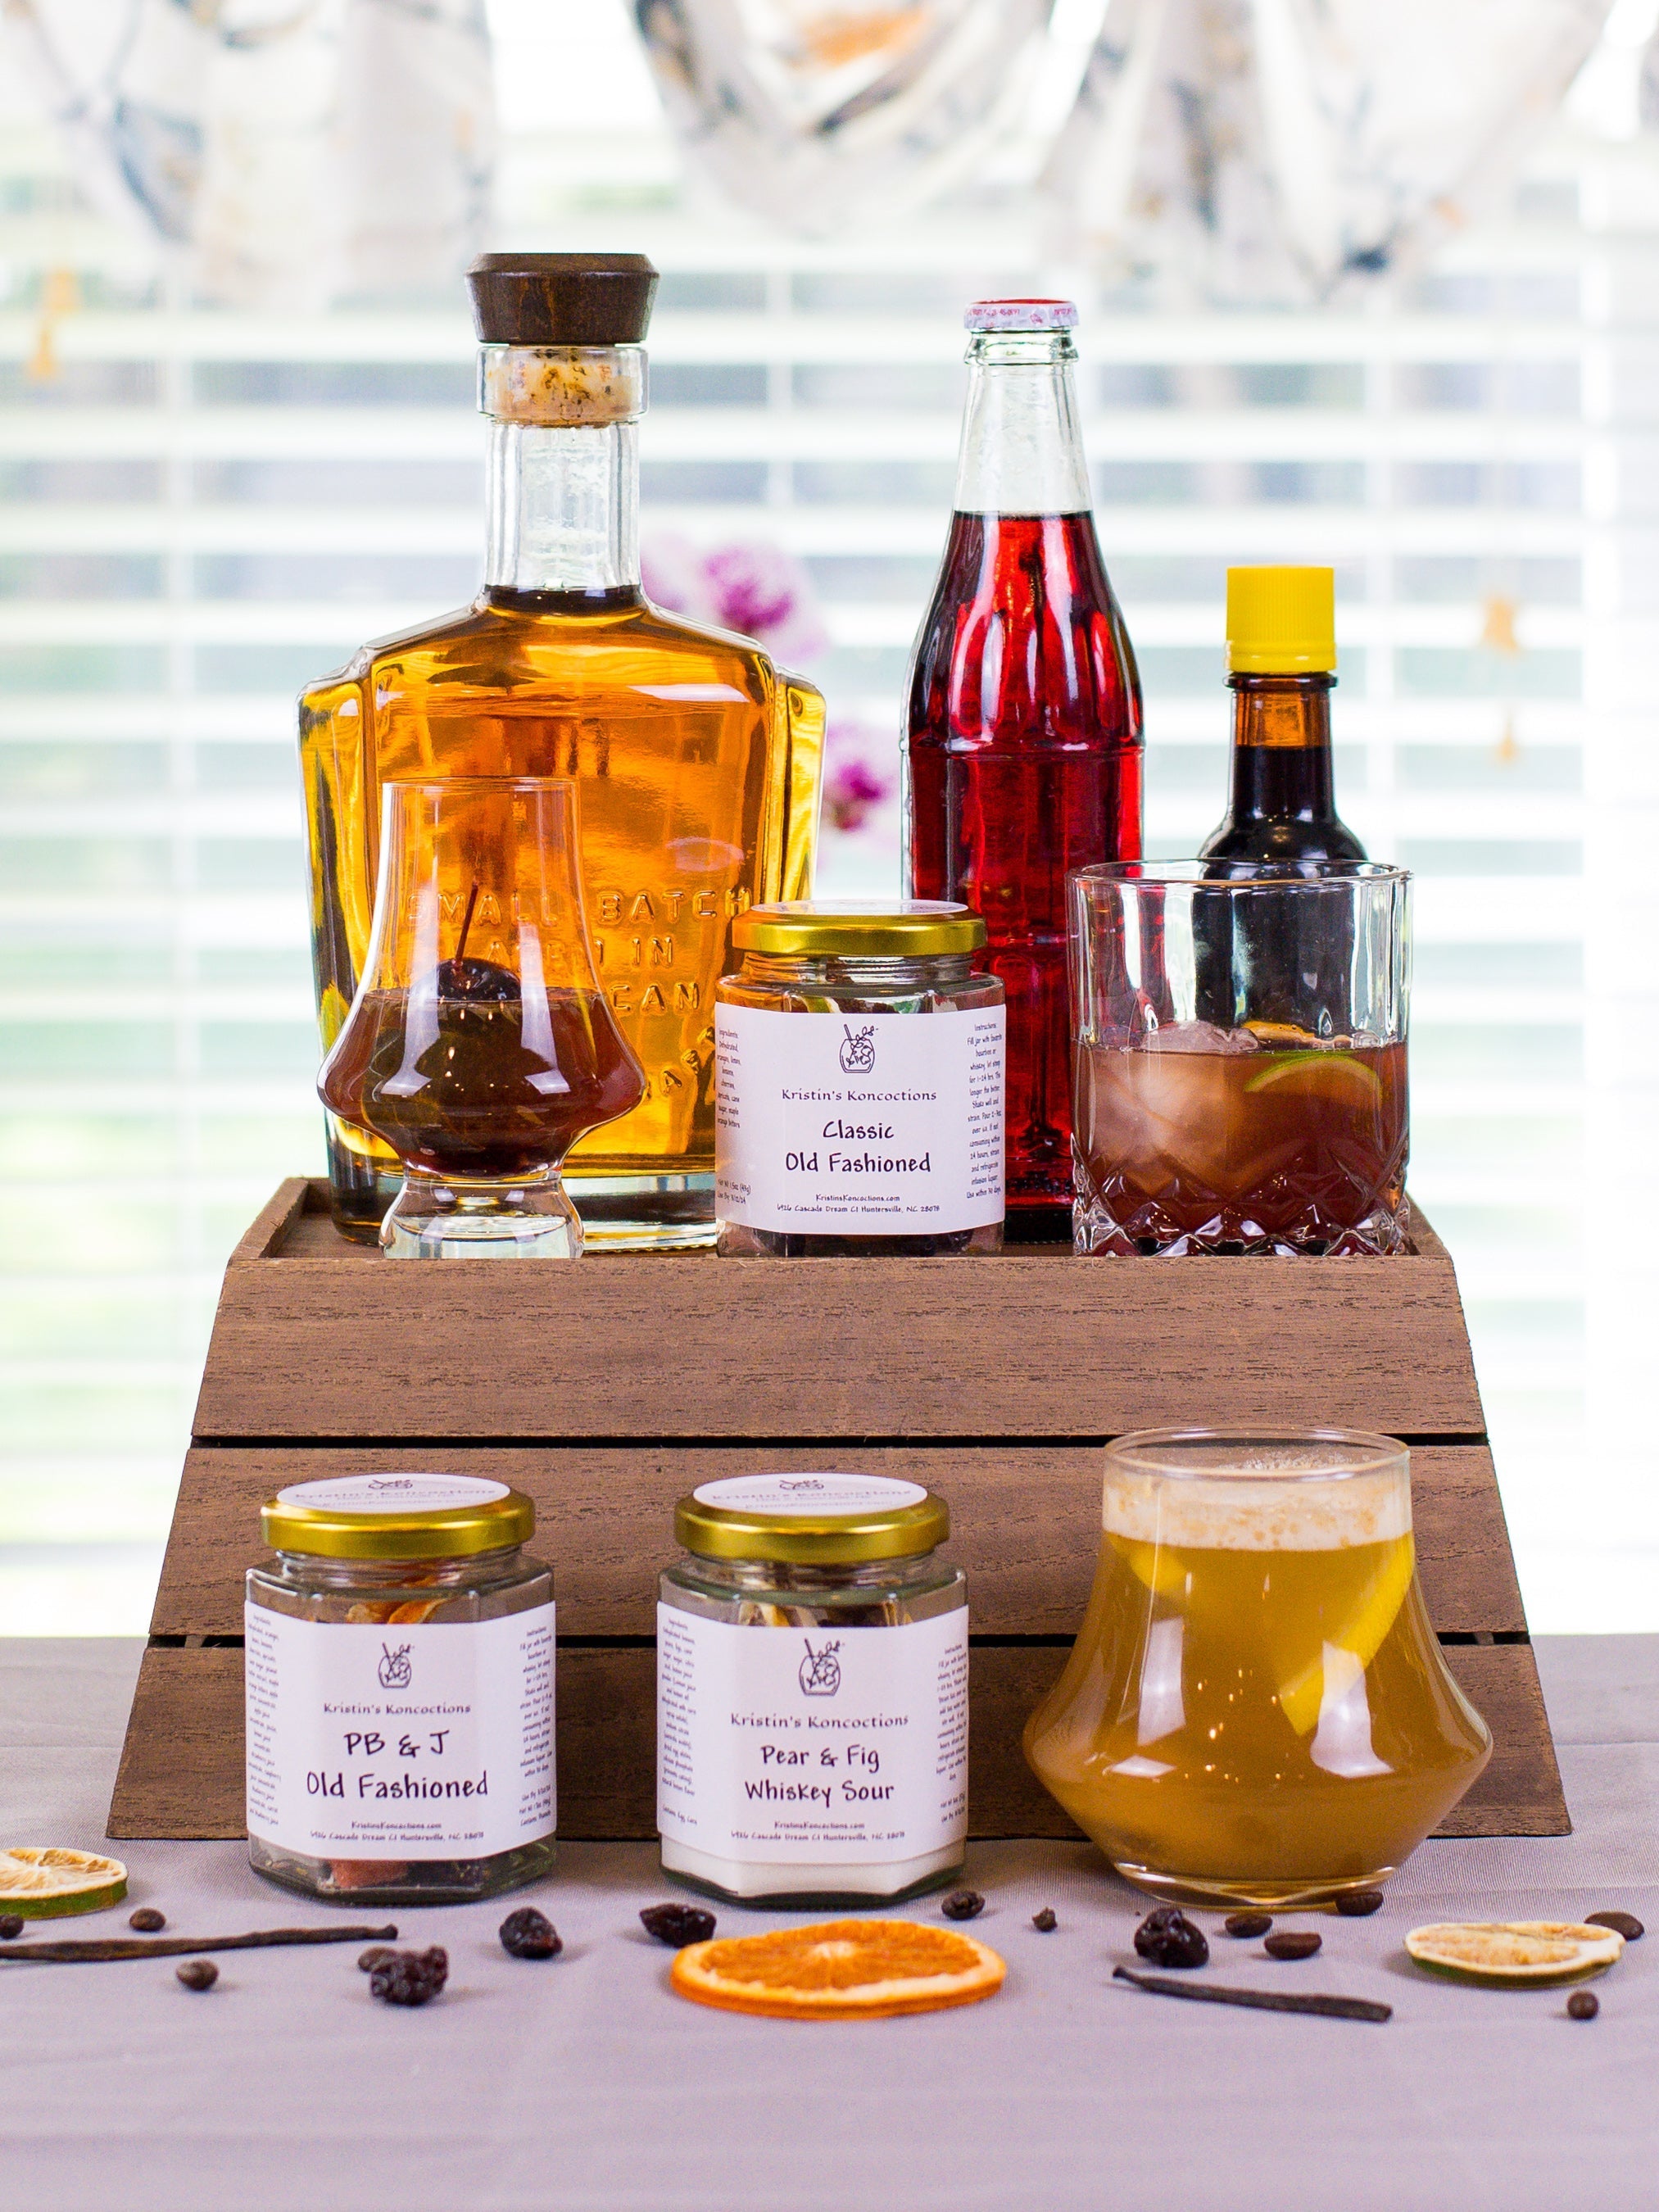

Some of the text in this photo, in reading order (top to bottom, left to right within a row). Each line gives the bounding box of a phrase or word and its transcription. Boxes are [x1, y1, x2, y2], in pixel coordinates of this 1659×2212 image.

[600, 887, 752, 923] BATCH
[632, 936, 673, 968] IN
[782, 1088, 937, 1101] Kristin's Koncoctions
[981, 1112, 990, 1120] Pour
[823, 1119, 895, 1140] Classic
[786, 1152, 931, 1172] Old Fashioned
[795, 1203, 823, 1212] Cascade
[826, 1203, 848, 1213] Dream
[861, 1204, 904, 1213] Huntersville,
[906, 1203, 918, 1213] NC
[816, 1194, 900, 1203] KristinsKoncoctions.com
[324, 1702, 472, 1715] Kristin's Koncoctions
[731, 1712, 909, 1729] Kristin's Koncoctions
[344, 1729, 450, 1758] PB & J
[760, 1743, 880, 1774] Pear & Fig
[306, 1770, 488, 1798] Old Fashioned
[745, 1779, 895, 1808] Whiskey Sour
